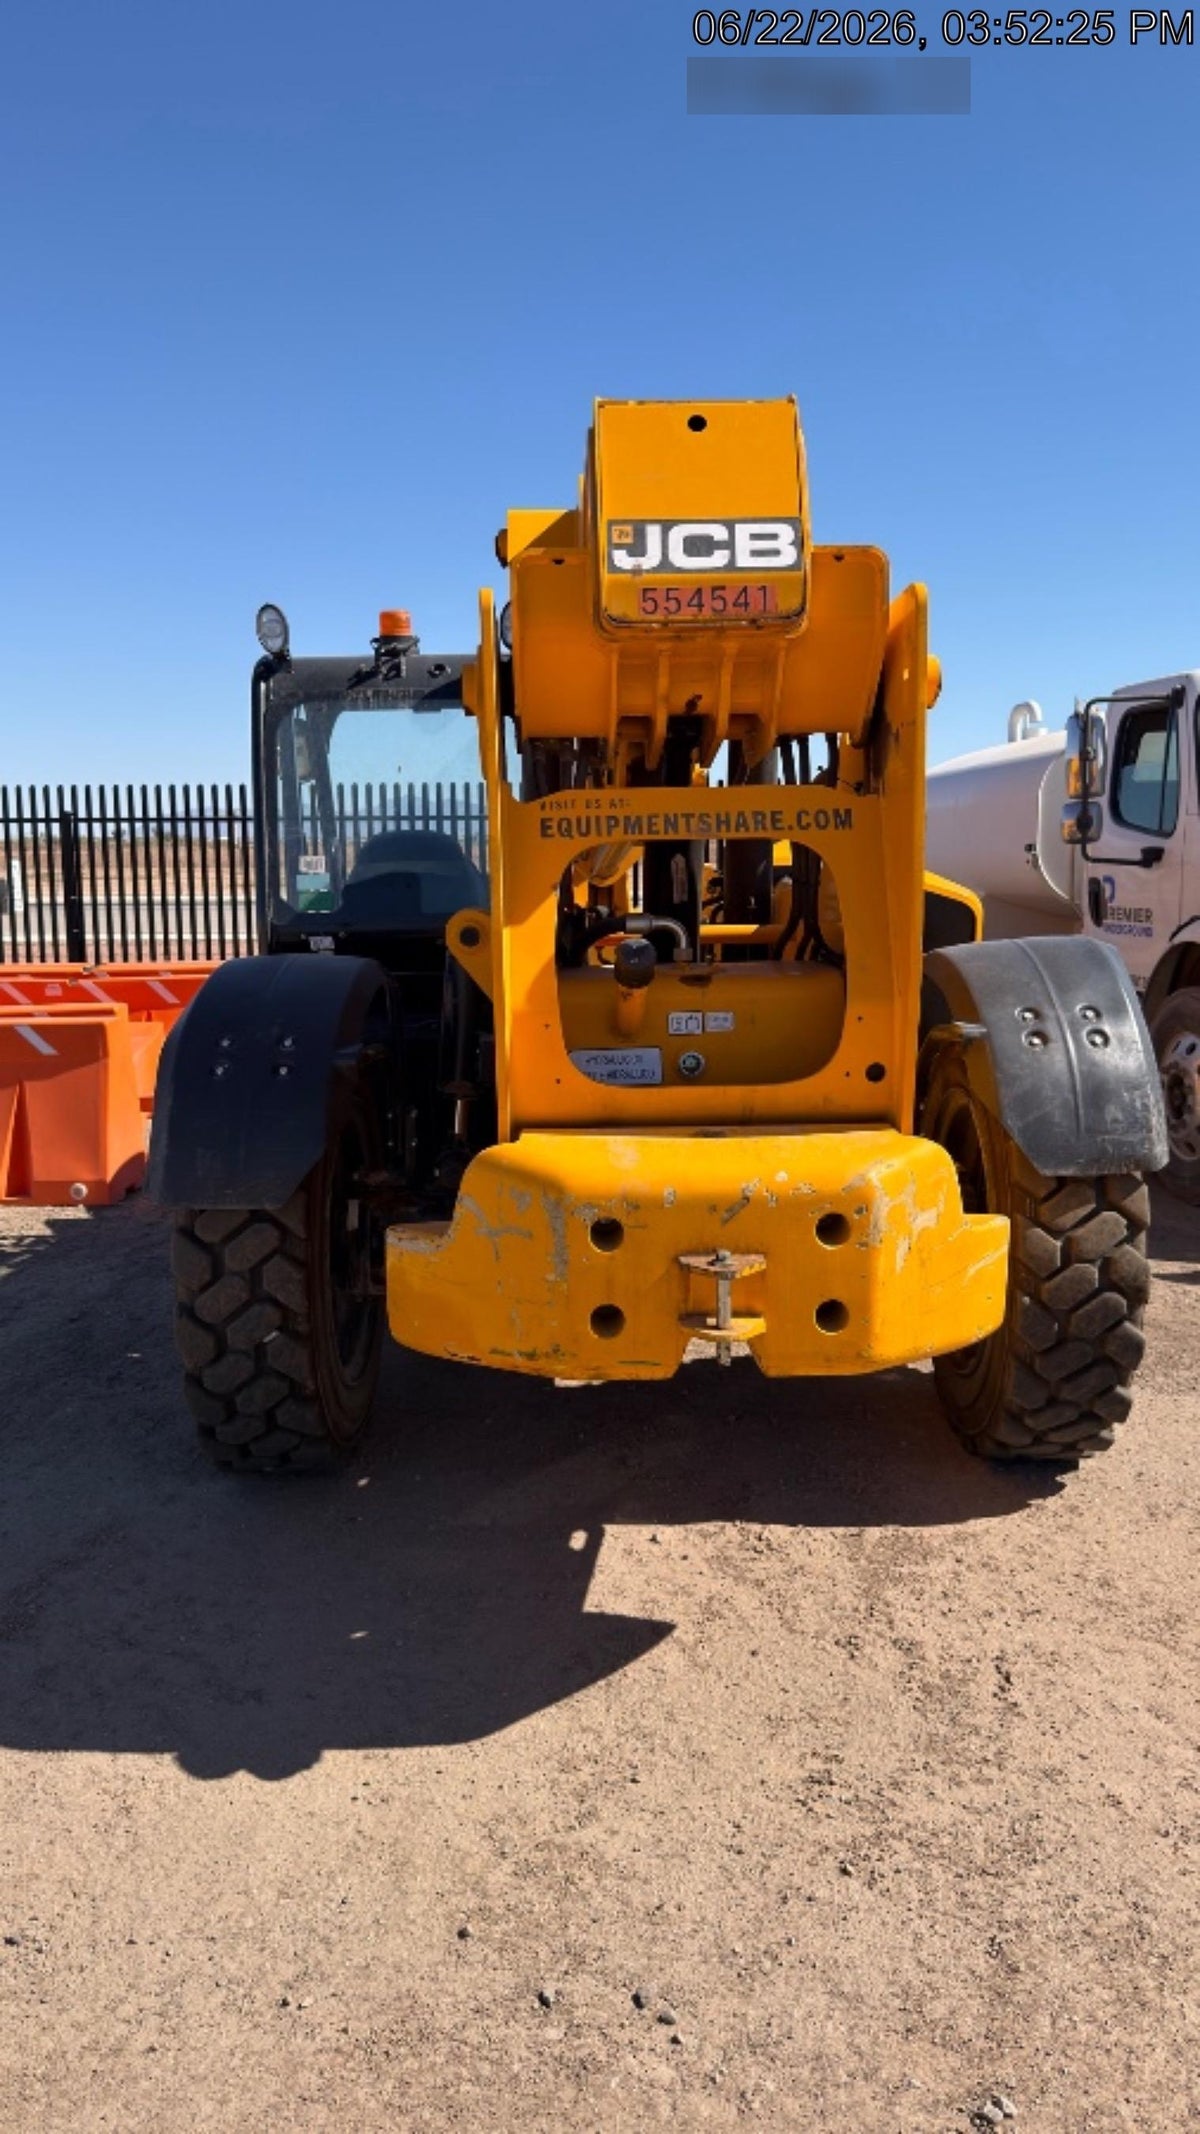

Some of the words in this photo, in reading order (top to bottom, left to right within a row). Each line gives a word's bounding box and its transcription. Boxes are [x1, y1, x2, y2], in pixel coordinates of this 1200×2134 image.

[611, 523, 798, 570] JCB
[641, 585, 768, 614] 554541
[540, 808, 853, 838] EQUIPMENTSHARE.COM
